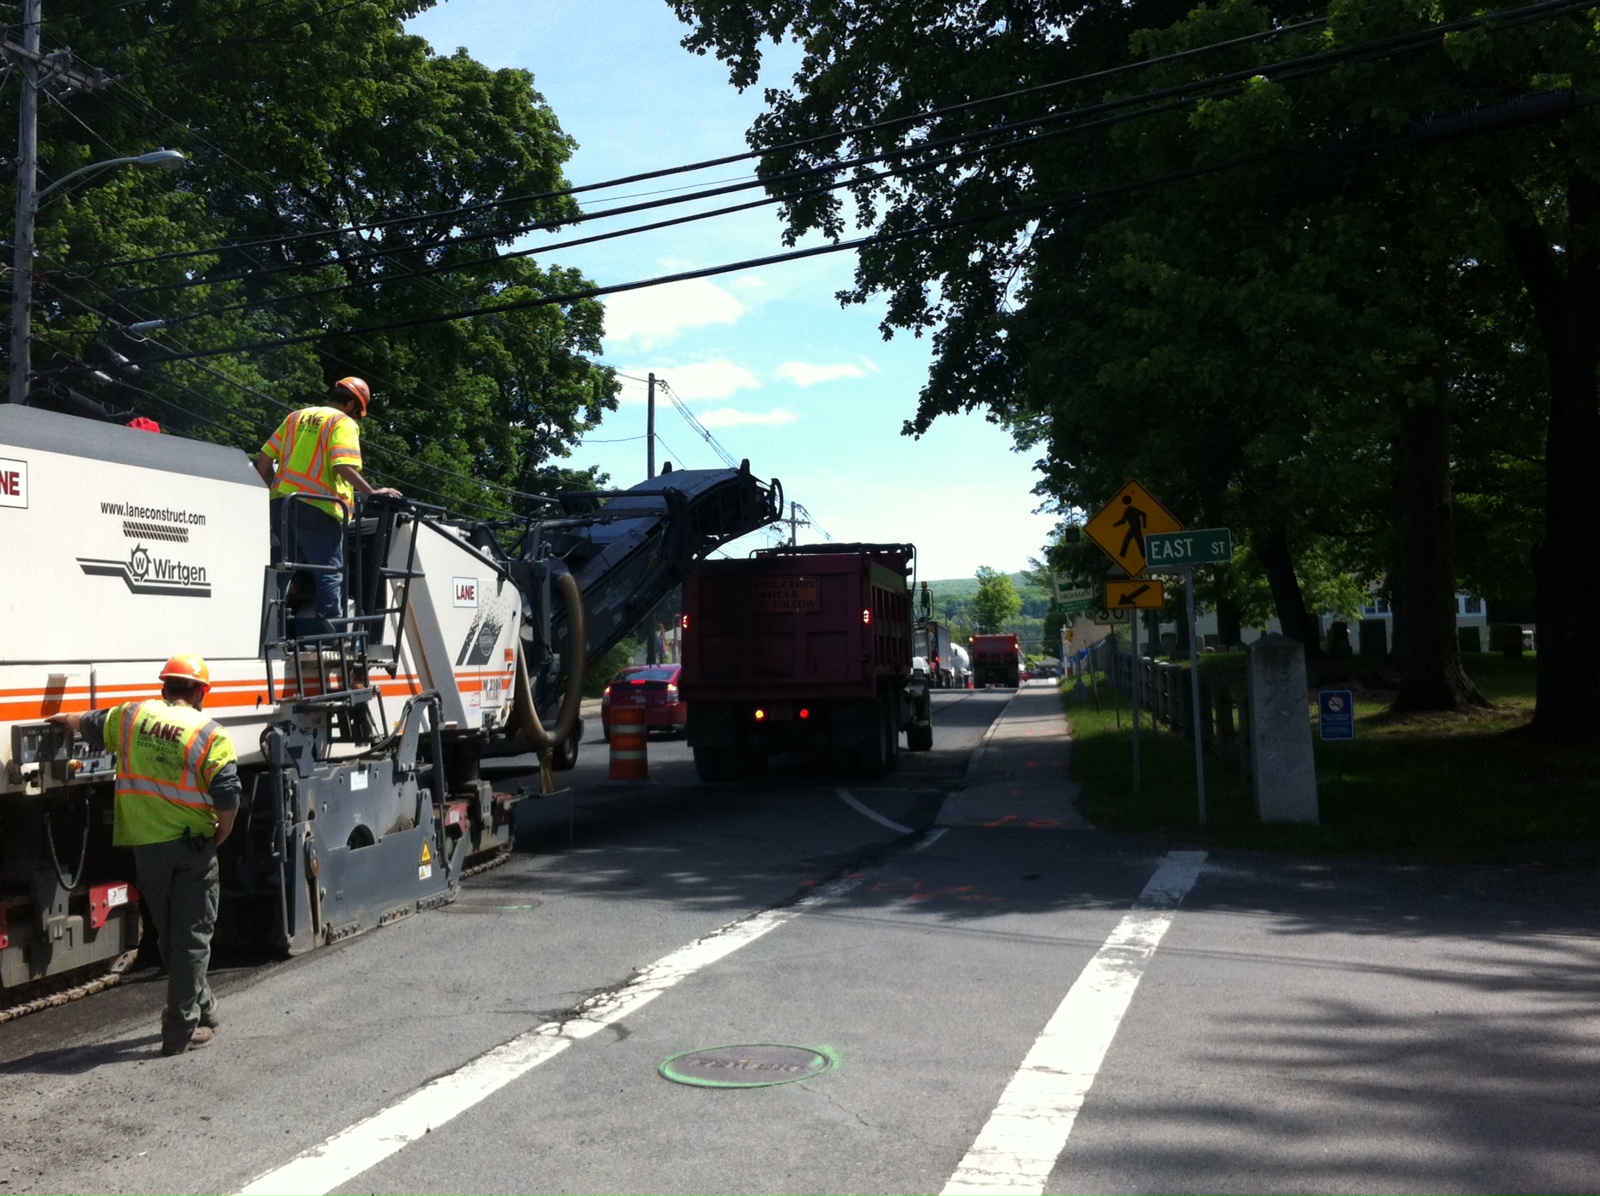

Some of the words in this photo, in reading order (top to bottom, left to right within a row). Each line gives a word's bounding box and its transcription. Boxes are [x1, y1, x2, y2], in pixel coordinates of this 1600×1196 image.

[299, 415, 324, 425] LANE
[0, 470, 20, 496] NE
[100, 501, 206, 525] www.laneconstruct.com
[1151, 538, 1193, 559] EAST
[1211, 541, 1225, 555] ST
[153, 558, 206, 586] Wirtgen
[456, 584, 475, 601] LANE
[140, 719, 185, 743] LANE
